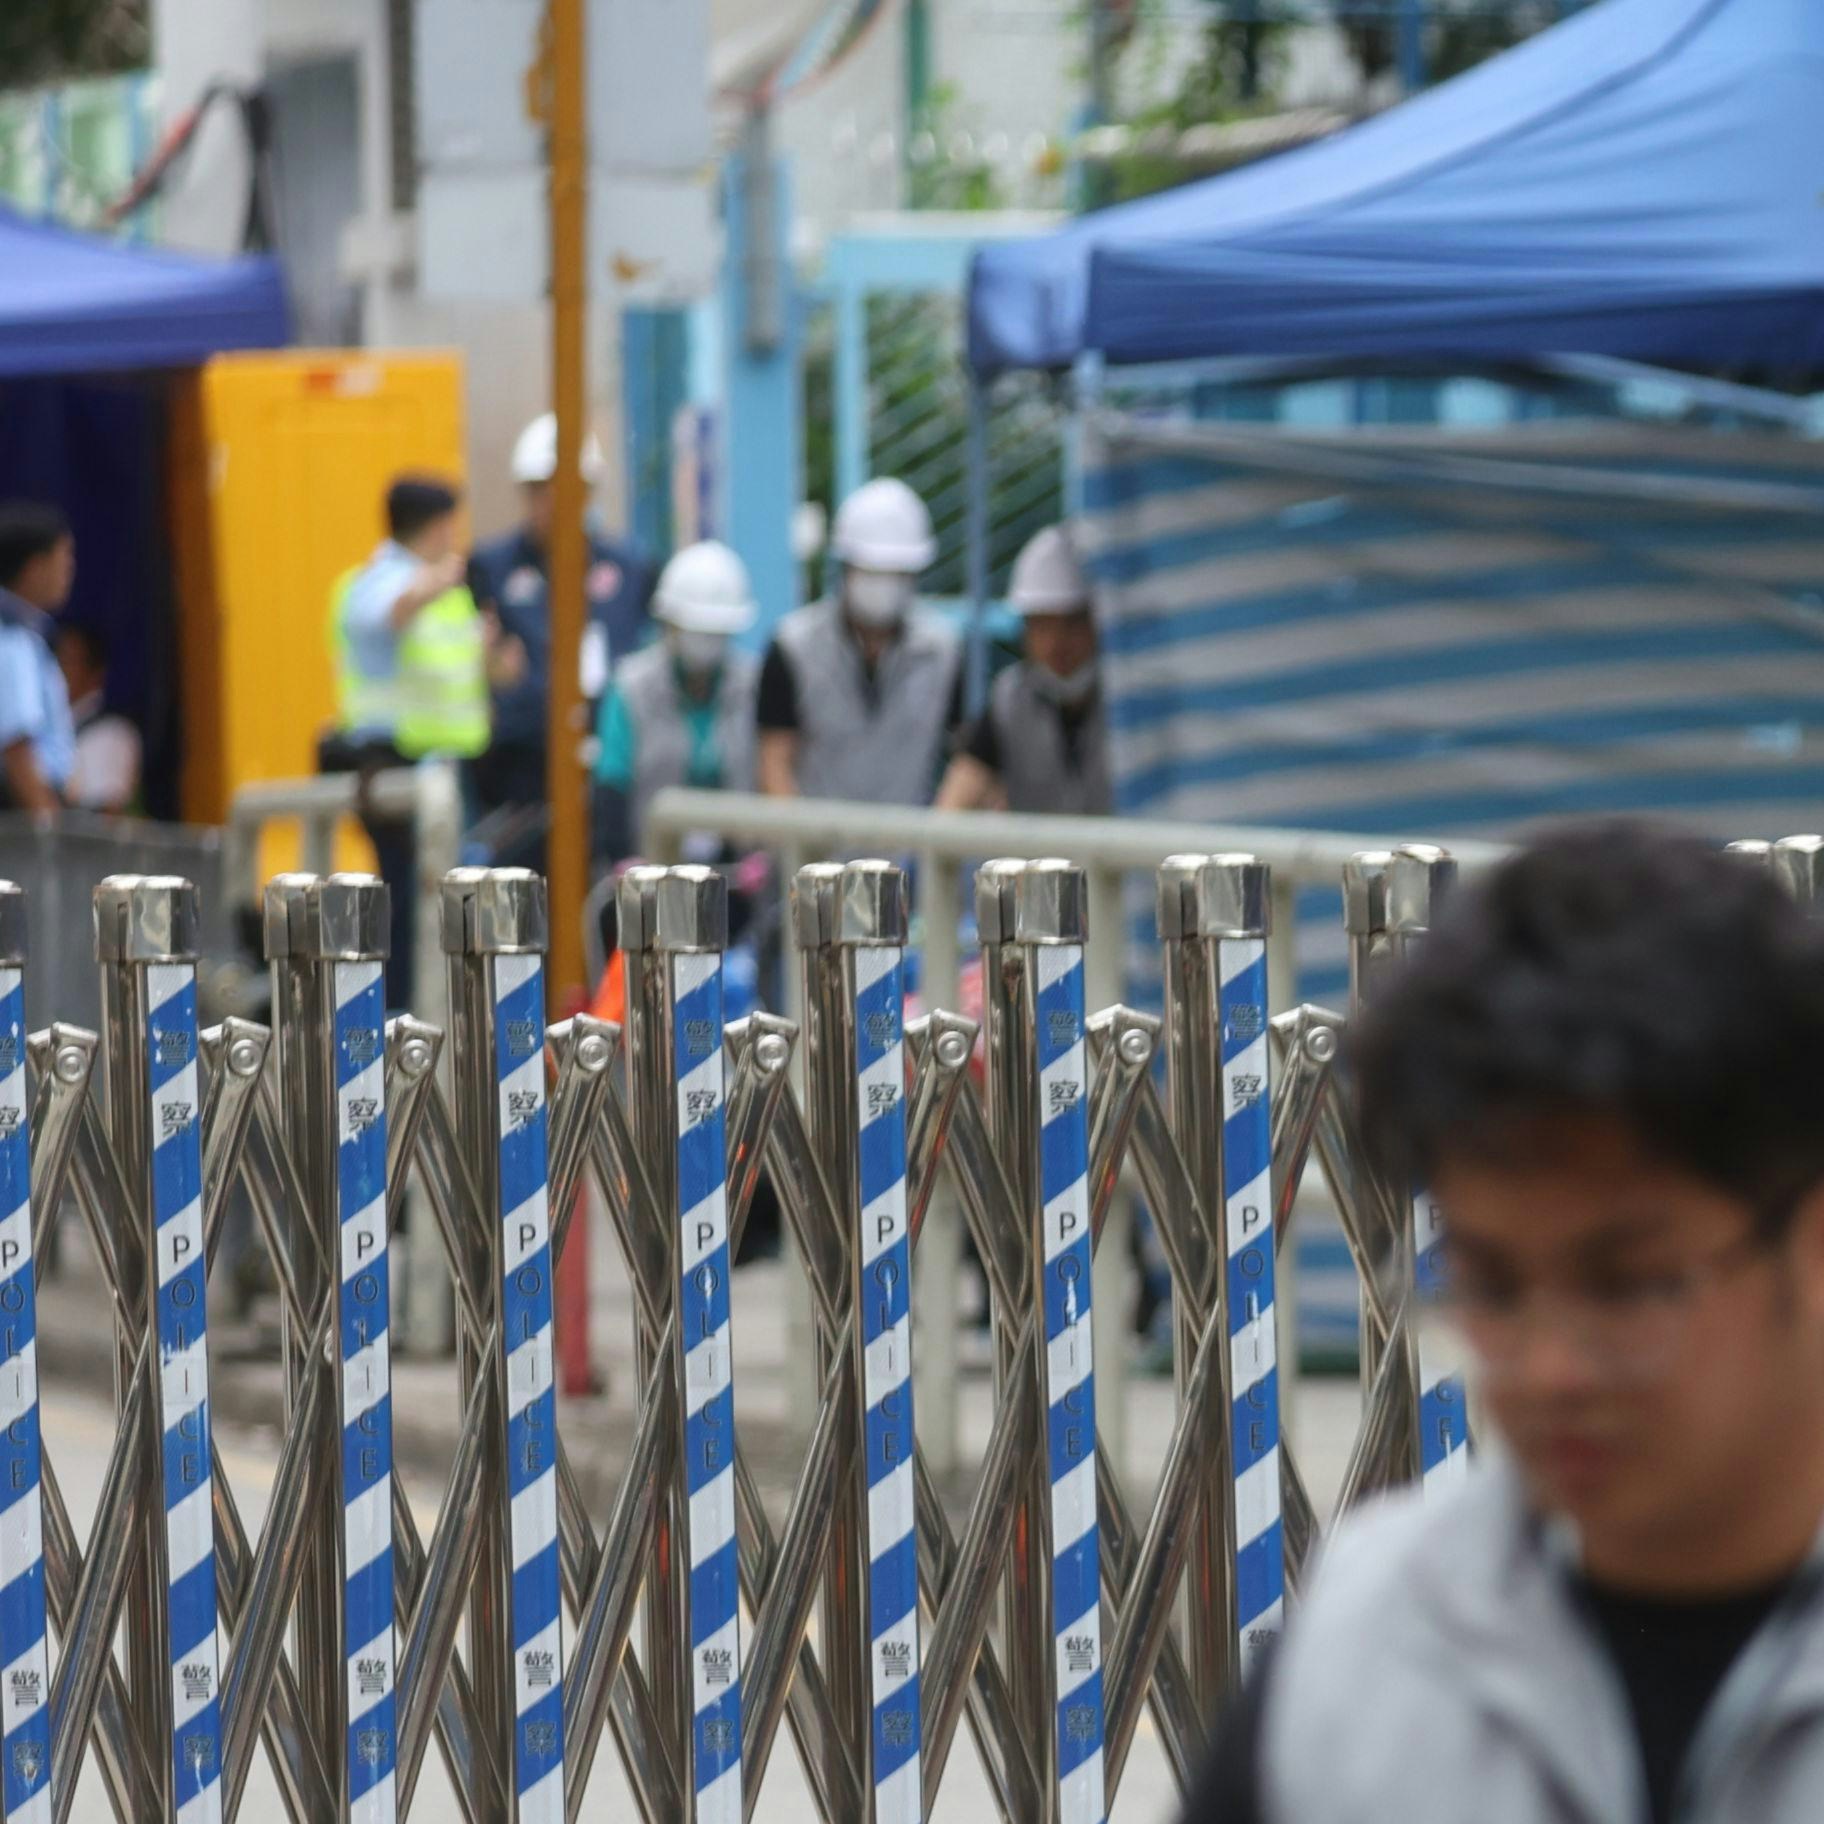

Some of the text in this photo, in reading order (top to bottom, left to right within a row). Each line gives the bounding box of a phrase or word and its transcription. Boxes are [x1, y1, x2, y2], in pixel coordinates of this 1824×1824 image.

[0, 1241, 27, 1490] POLICE
[160, 1030, 198, 1484] 警察 POLICE
[343, 1027, 380, 1481] 警察 POLICE
[506, 1020, 542, 1472] 警察 POLICE
[685, 1019, 721, 1471] 警察 POLICE
[865, 1011, 900, 1463] 警察 POLICE
[1048, 1010, 1083, 1458] 警察 POLICE
[1229, 1003, 1267, 1451] 警察 POLICE
[182, 1665, 214, 1771] 警察
[356, 1658, 389, 1762] 警察
[524, 1651, 556, 1755] 警察
[702, 1649, 733, 1753] 警察
[880, 1640, 912, 1745] 警察
[1065, 1635, 1096, 1742] 警察
